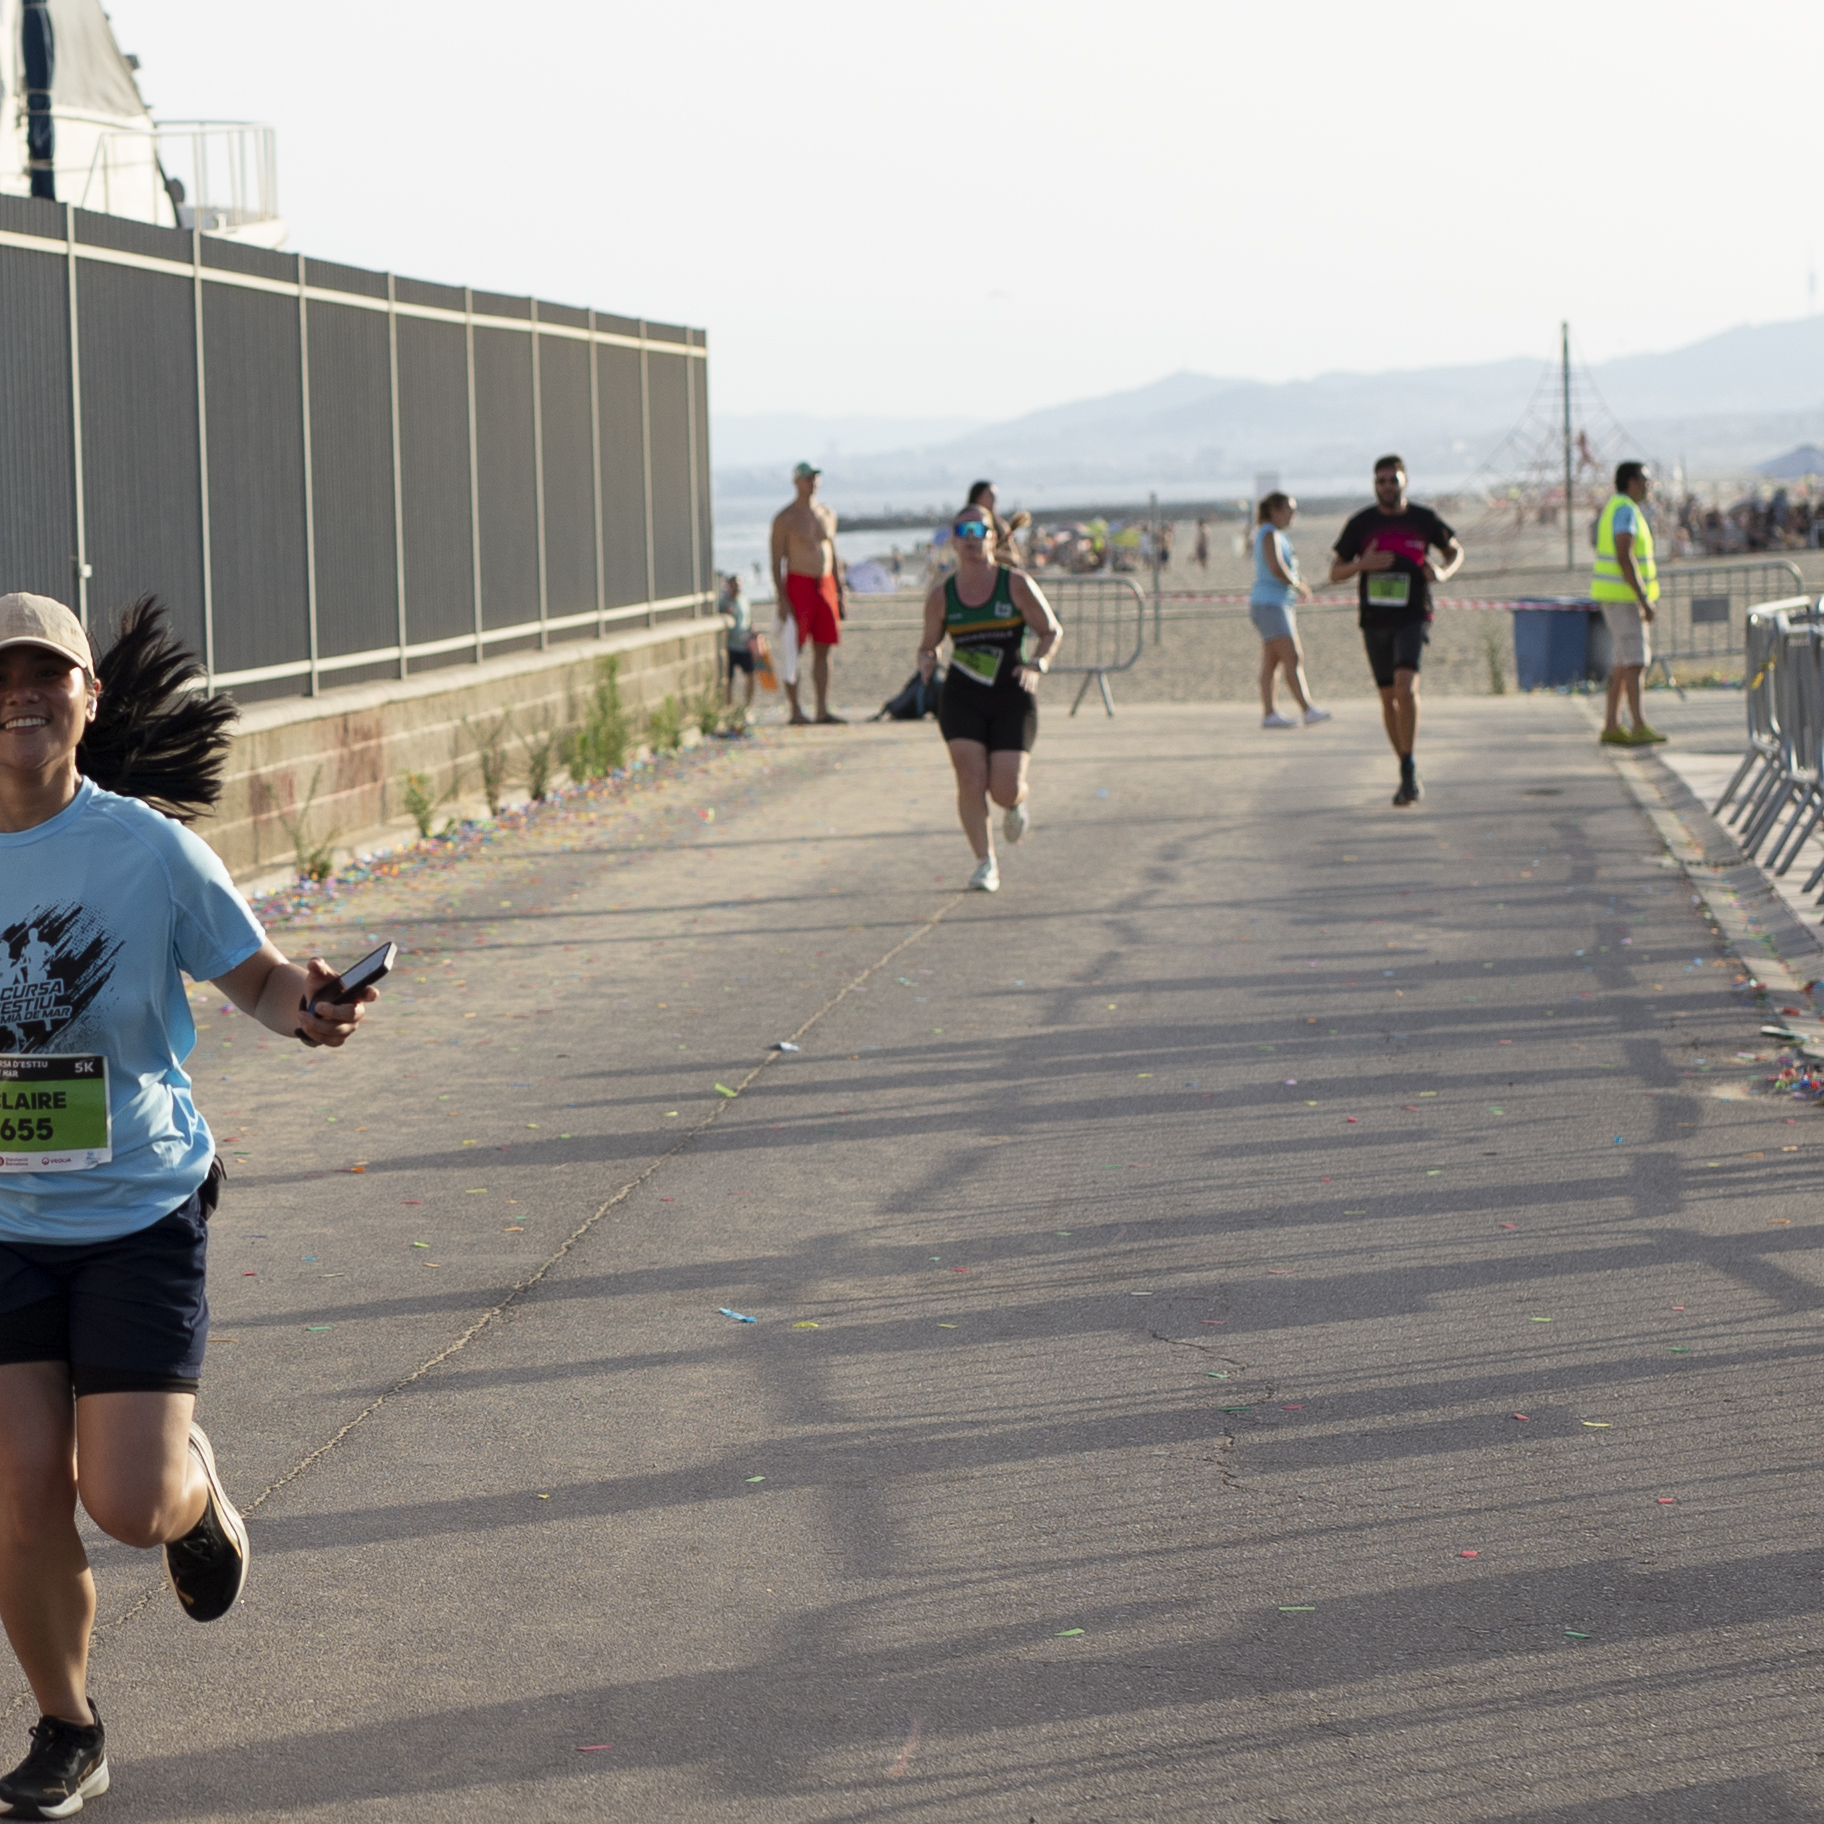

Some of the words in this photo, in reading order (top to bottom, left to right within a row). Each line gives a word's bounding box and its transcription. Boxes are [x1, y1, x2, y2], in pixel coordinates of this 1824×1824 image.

[0, 980, 62, 1001] CURSA
[24, 1010, 40, 1021] DE
[42, 1007, 71, 1018] MAR
[12, 1060, 49, 1069] D'ESTIU
[74, 1062, 95, 1073] 5K
[2, 1070, 19, 1078] MAR
[0, 1118, 54, 1141] 655
